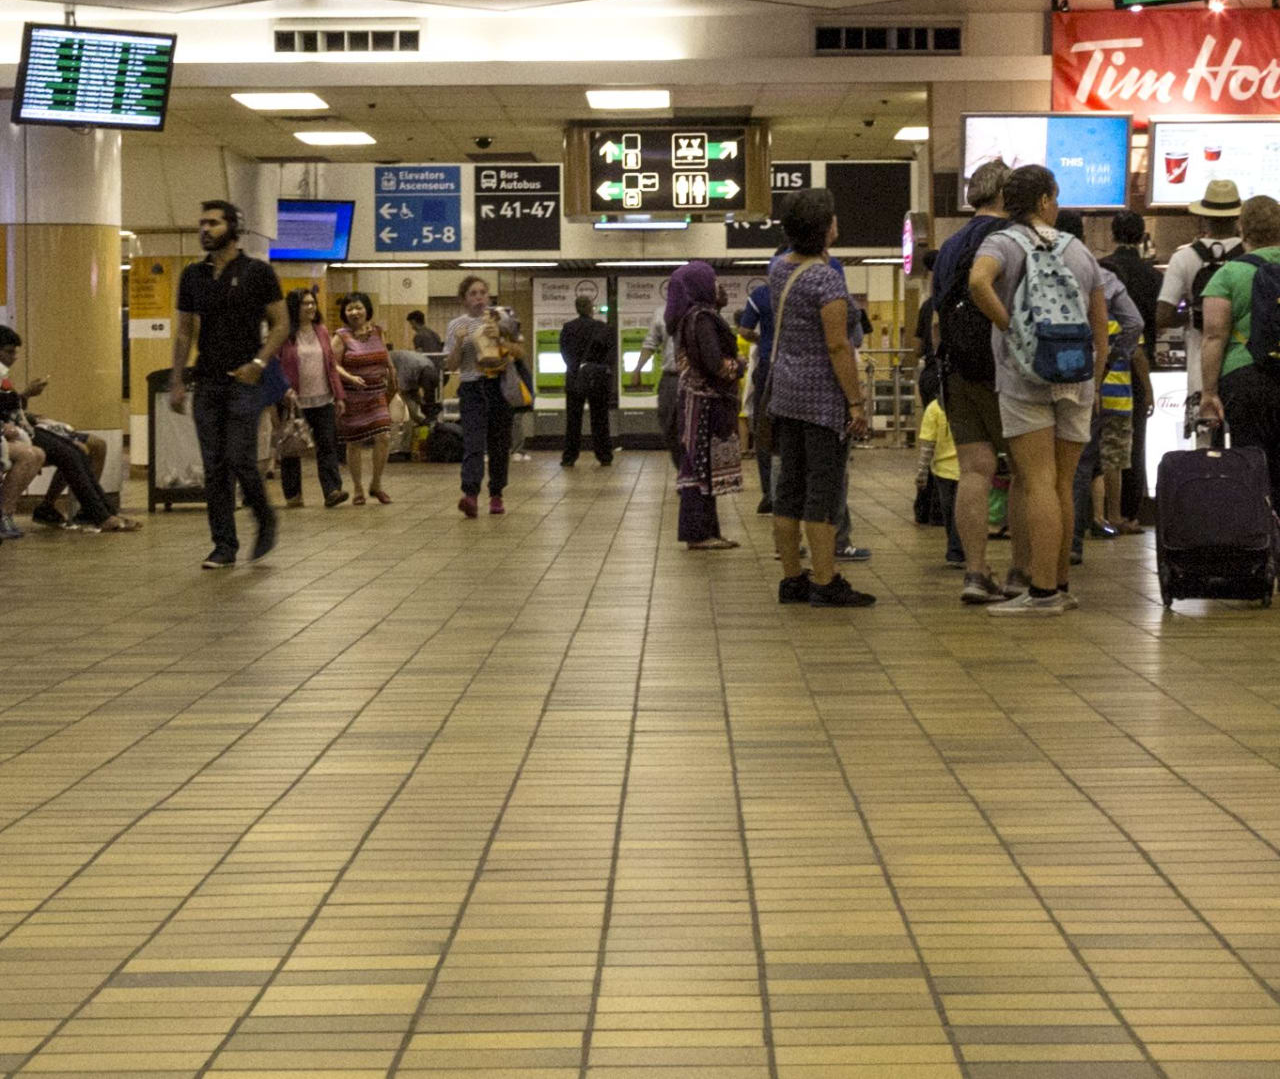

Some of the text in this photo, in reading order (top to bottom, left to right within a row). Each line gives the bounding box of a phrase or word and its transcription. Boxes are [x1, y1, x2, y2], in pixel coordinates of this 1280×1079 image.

[1070, 37, 1176, 104] Tim
[1060, 157, 1084, 167] THIS
[399, 170, 445, 181] Elevators
[499, 170, 519, 180] Bus
[399, 181, 455, 191] Ascenseurs
[499, 180, 542, 190] Autobus
[500, 201, 556, 219] 41-47
[542, 282, 570, 291] Tickets
[626, 281, 654, 290] Tickets
[542, 293, 566, 301] Billets
[626, 292, 651, 300] Billets
